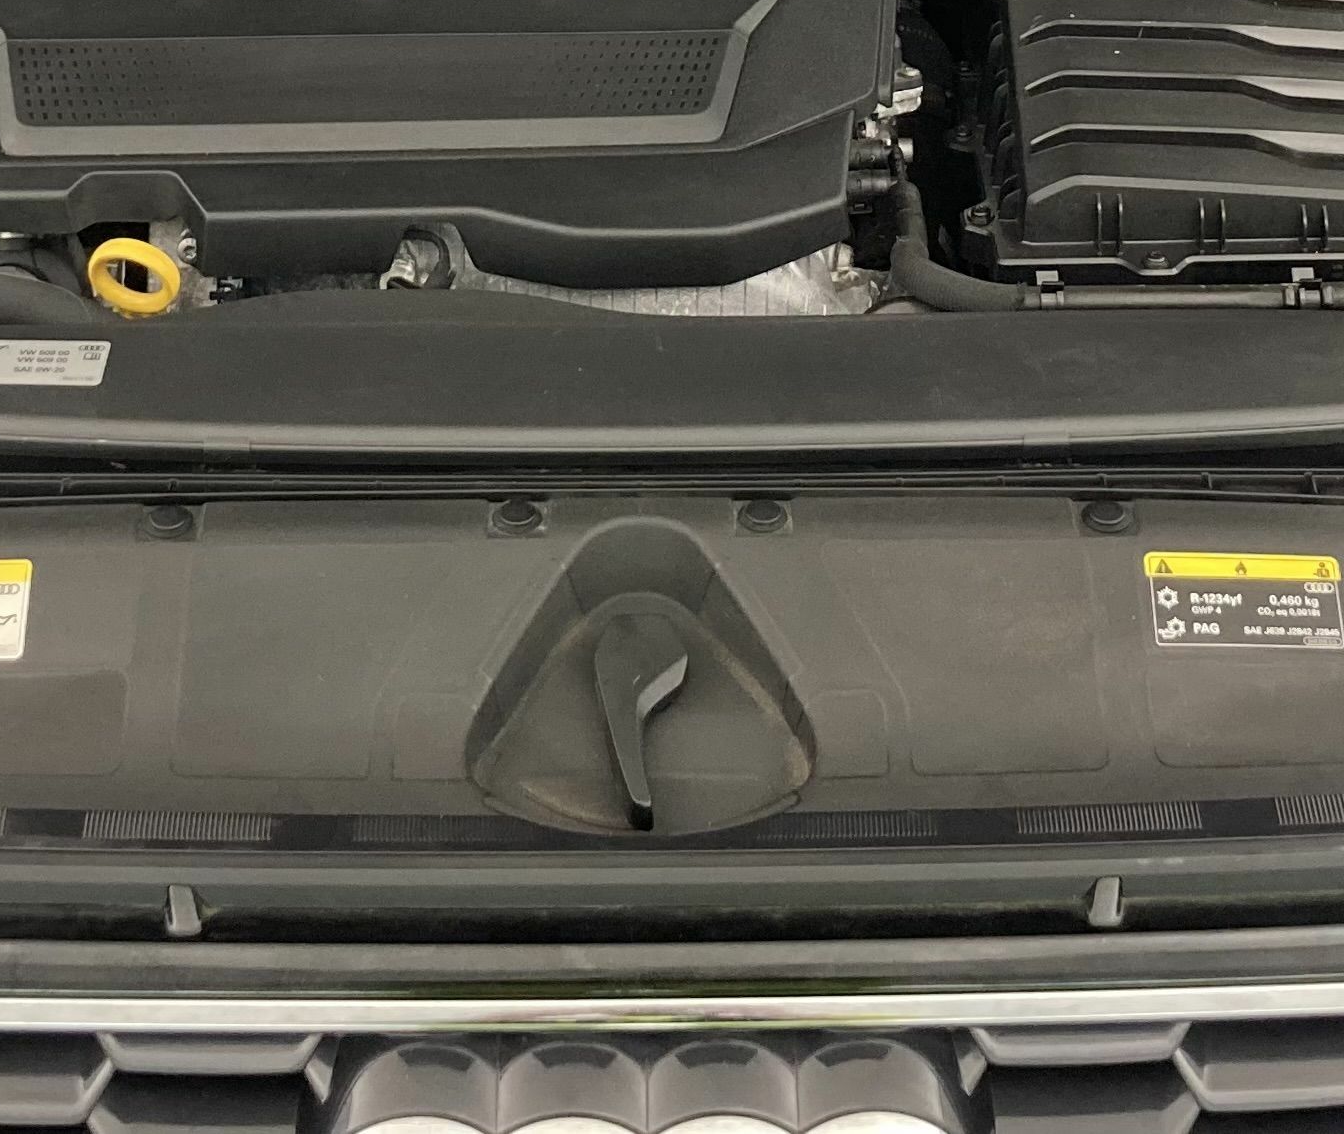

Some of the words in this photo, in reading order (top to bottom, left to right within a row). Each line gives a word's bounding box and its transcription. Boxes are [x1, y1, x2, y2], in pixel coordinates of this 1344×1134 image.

[1189, 592, 1242, 607] R-1234yf
[1268, 594, 1303, 607] 0,460
[1304, 595, 1319, 608] kg
[1191, 606, 1214, 614] GWP
[1193, 622, 1220, 635] PAG
[1243, 625, 1262, 635] SAE
